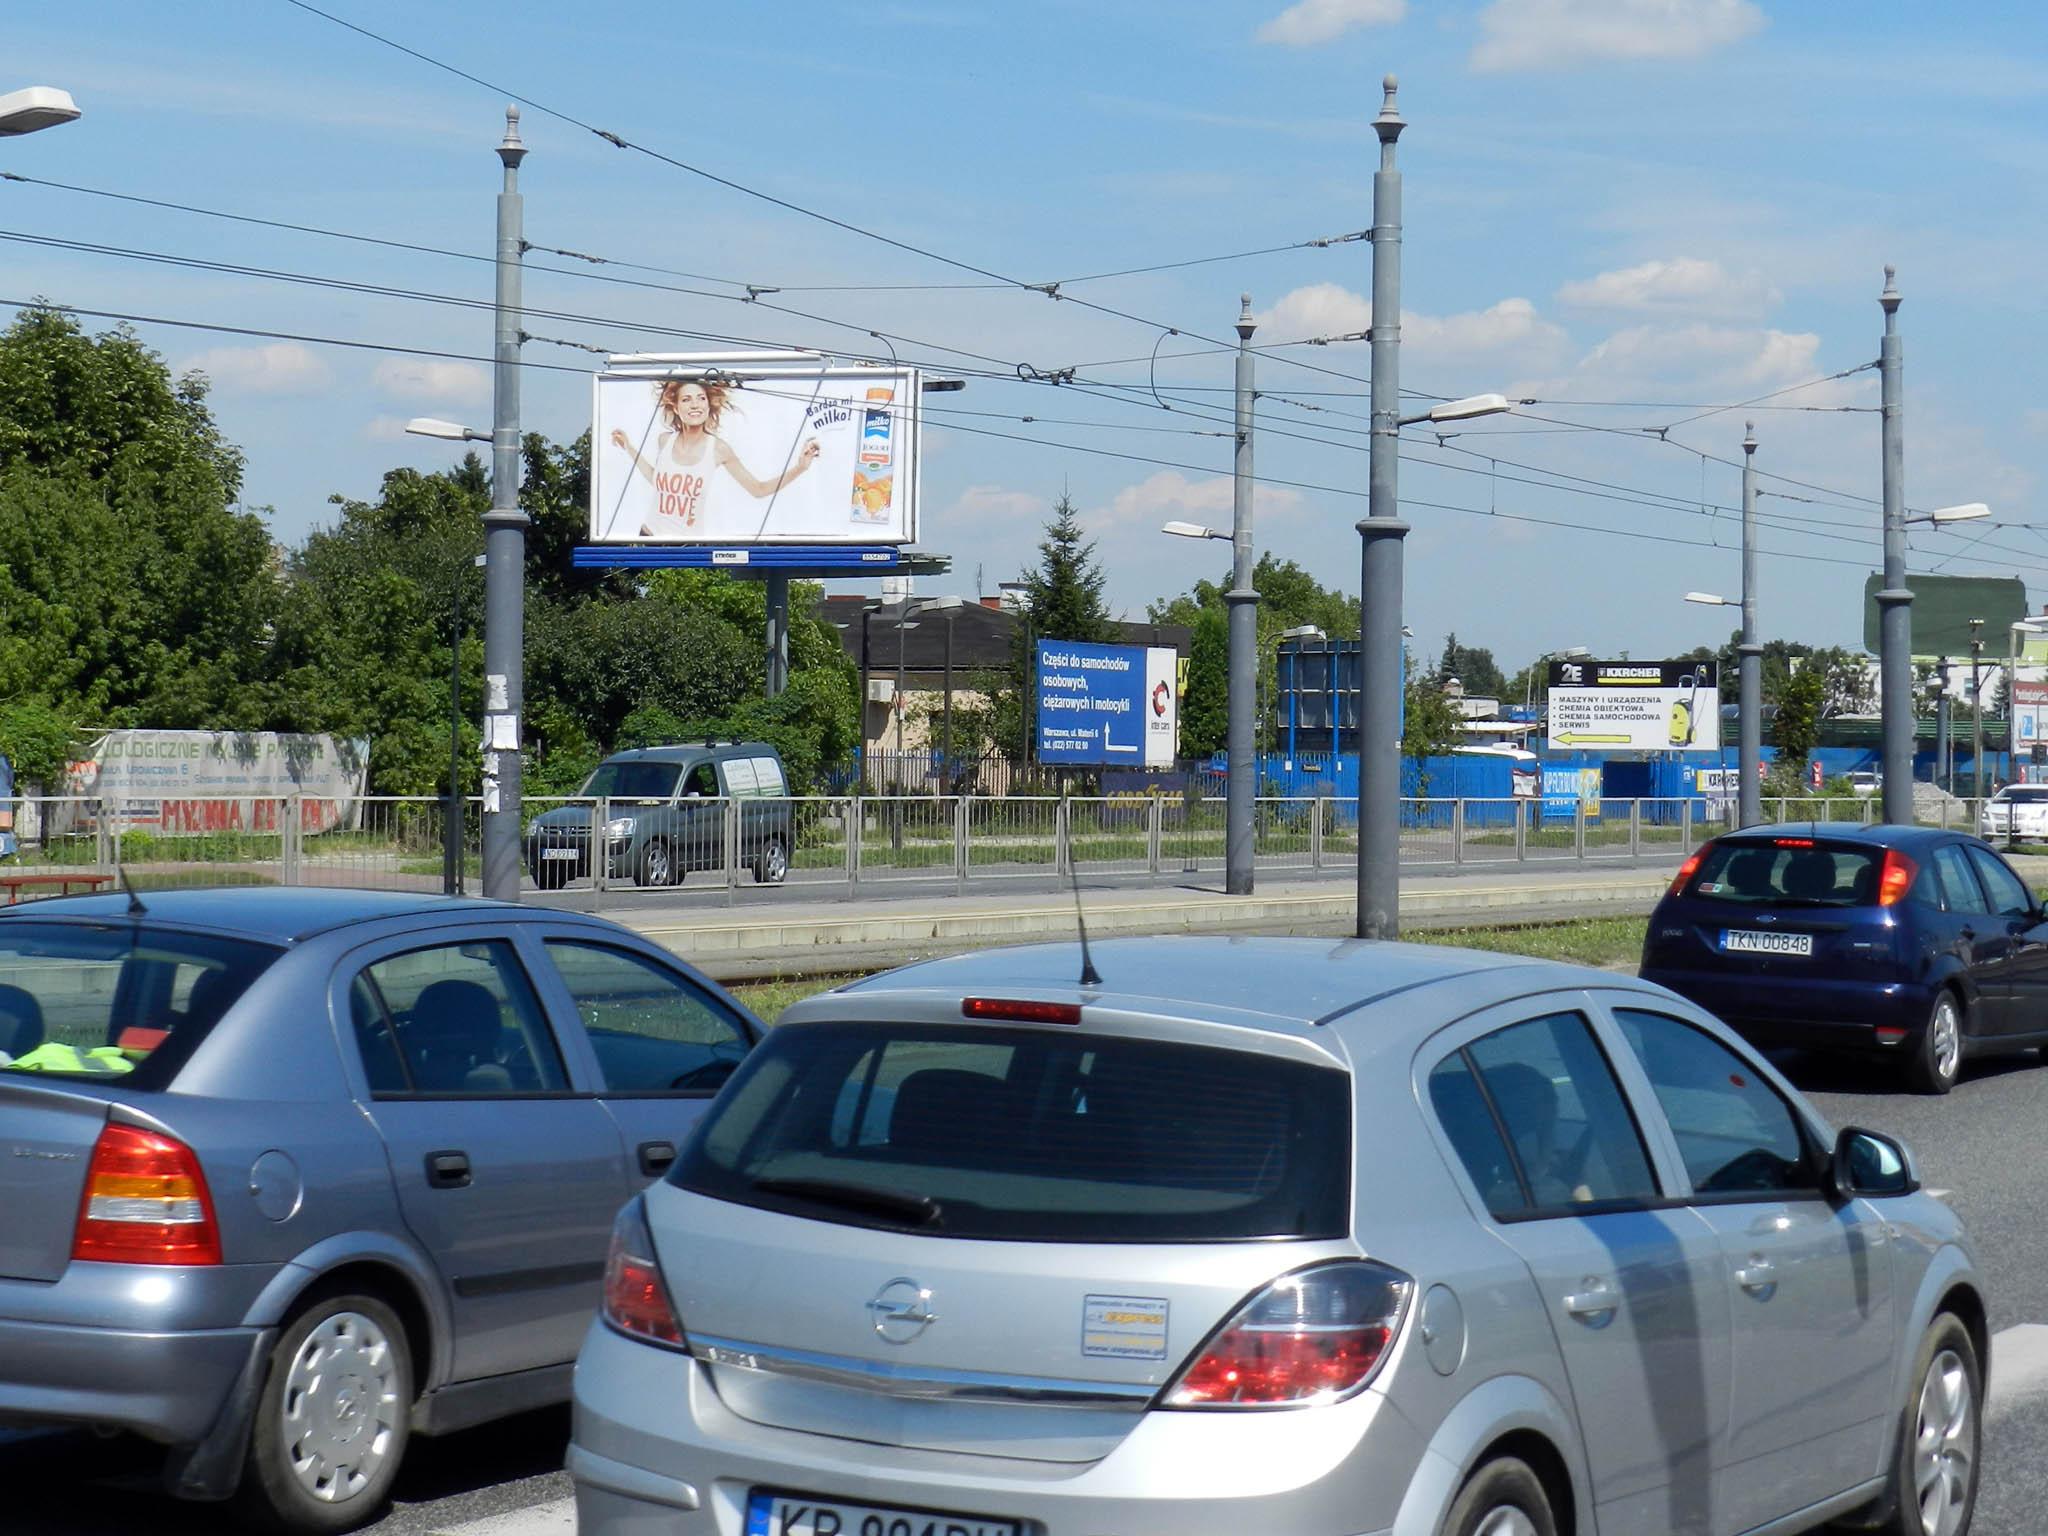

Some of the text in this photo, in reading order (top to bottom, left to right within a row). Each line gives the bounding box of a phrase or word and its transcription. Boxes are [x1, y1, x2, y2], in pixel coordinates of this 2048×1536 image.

[813, 408, 852, 429] milko!
[659, 493, 697, 517] LOVE
[1042, 651, 1130, 671] Części do samochodów
[1561, 663, 1583, 682] 2E
[1043, 673, 1089, 692] osobowych,
[1043, 693, 1090, 712] ciężarowych
[1095, 697, 1130, 714] motocykli
[1607, 696, 1662, 705] URZĄDZENIA
[1558, 721, 1590, 729] SERWIS
[1593, 713, 1661, 721] SAMOCHODOWA
[1729, 931, 1759, 949] TKN
[1762, 933, 1809, 953] 00848
